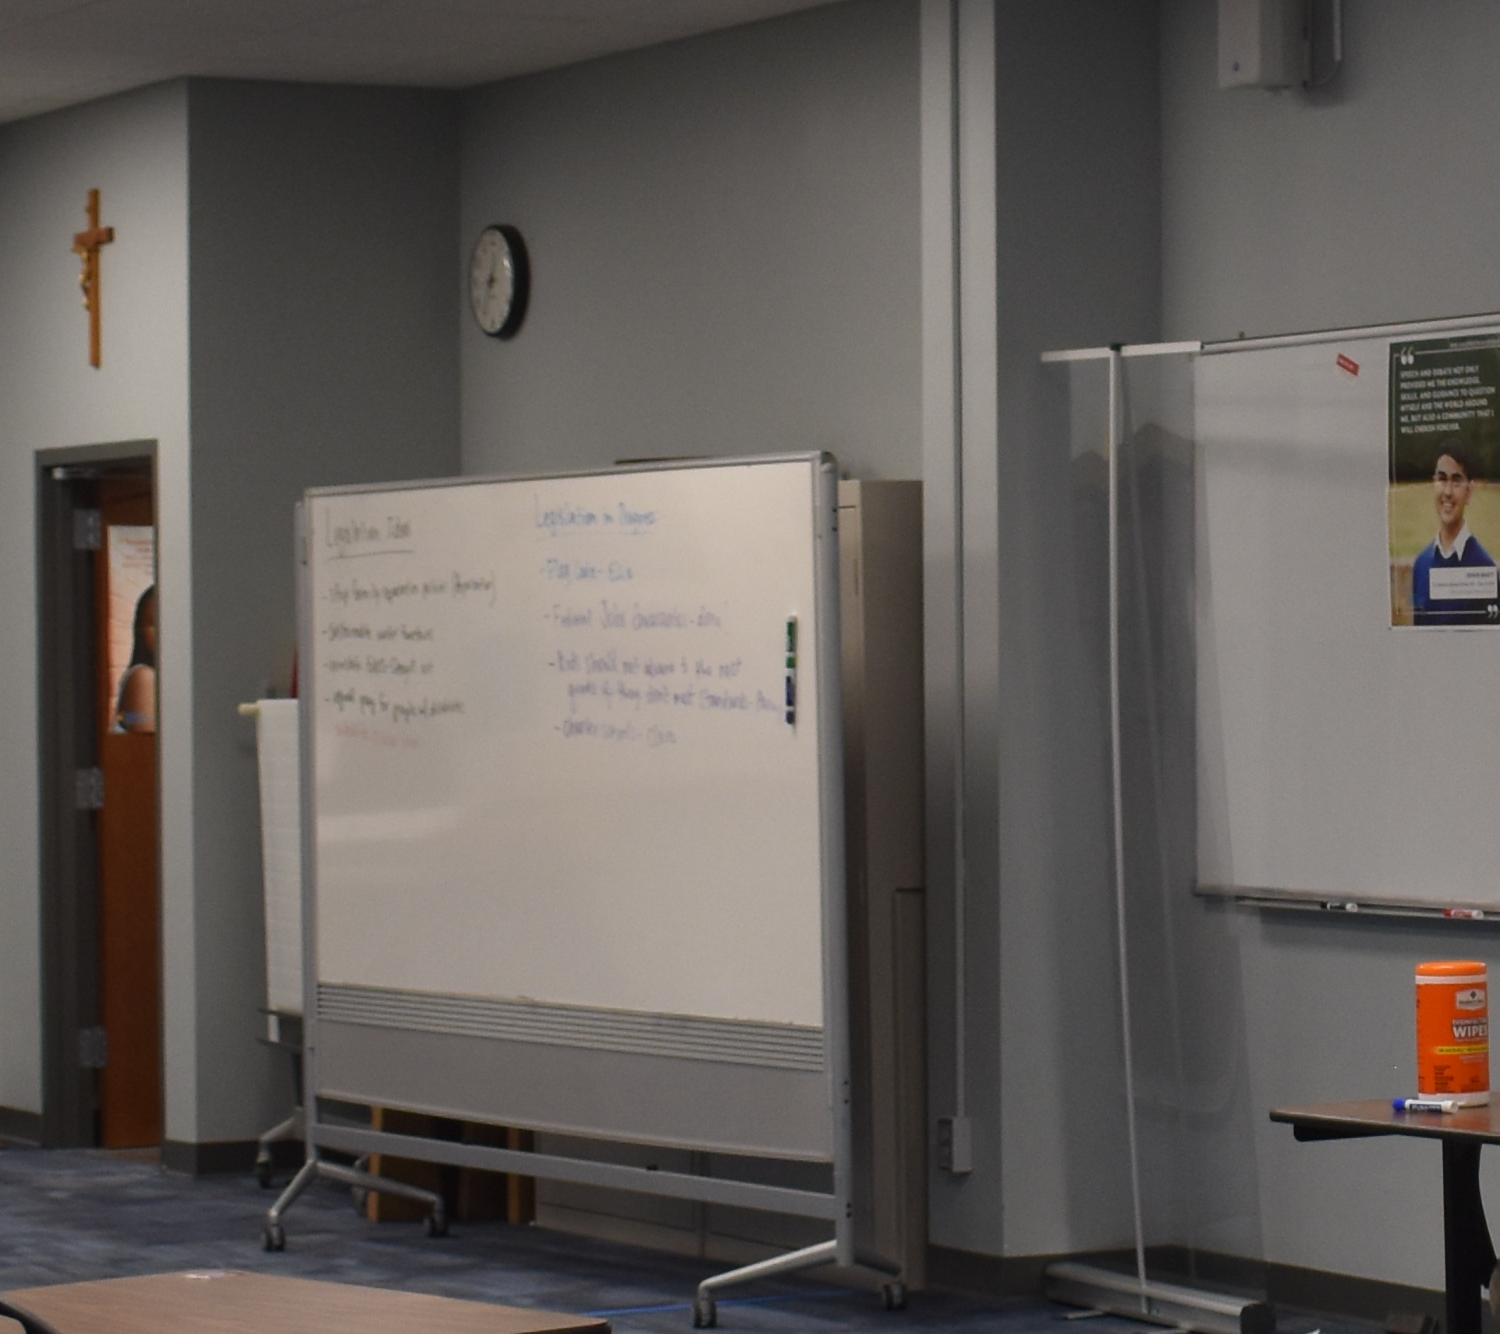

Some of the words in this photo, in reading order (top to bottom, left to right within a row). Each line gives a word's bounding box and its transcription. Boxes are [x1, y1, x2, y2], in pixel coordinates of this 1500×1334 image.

[1420, 369, 1432, 377] AND
[1433, 368, 1452, 376] DEBATE
[1453, 366, 1464, 375] NOT
[1465, 365, 1479, 373] ONLY
[1400, 381, 1426, 389] PROVIDED
[1436, 378, 1446, 387] THE
[1420, 391, 1431, 399] AND
[1460, 388, 1468, 396] TO
[1469, 386, 1496, 396] QUESTION
[1400, 403, 1420, 411] MYSELF
[1421, 402, 1432, 410] AND
[1433, 401, 1443, 409] THE
[1444, 400, 1464, 409] WORLD
[1465, 398, 1488, 407] AROUND
[1411, 414, 1422, 422] BUT
[1422, 413, 1437, 421] ALSO
[1442, 410, 1476, 420] COMMUNITY
[1477, 409, 1490, 417] THAT
[1400, 426, 1413, 434] WILL
[1453, 1025, 1488, 1039] WIPES
